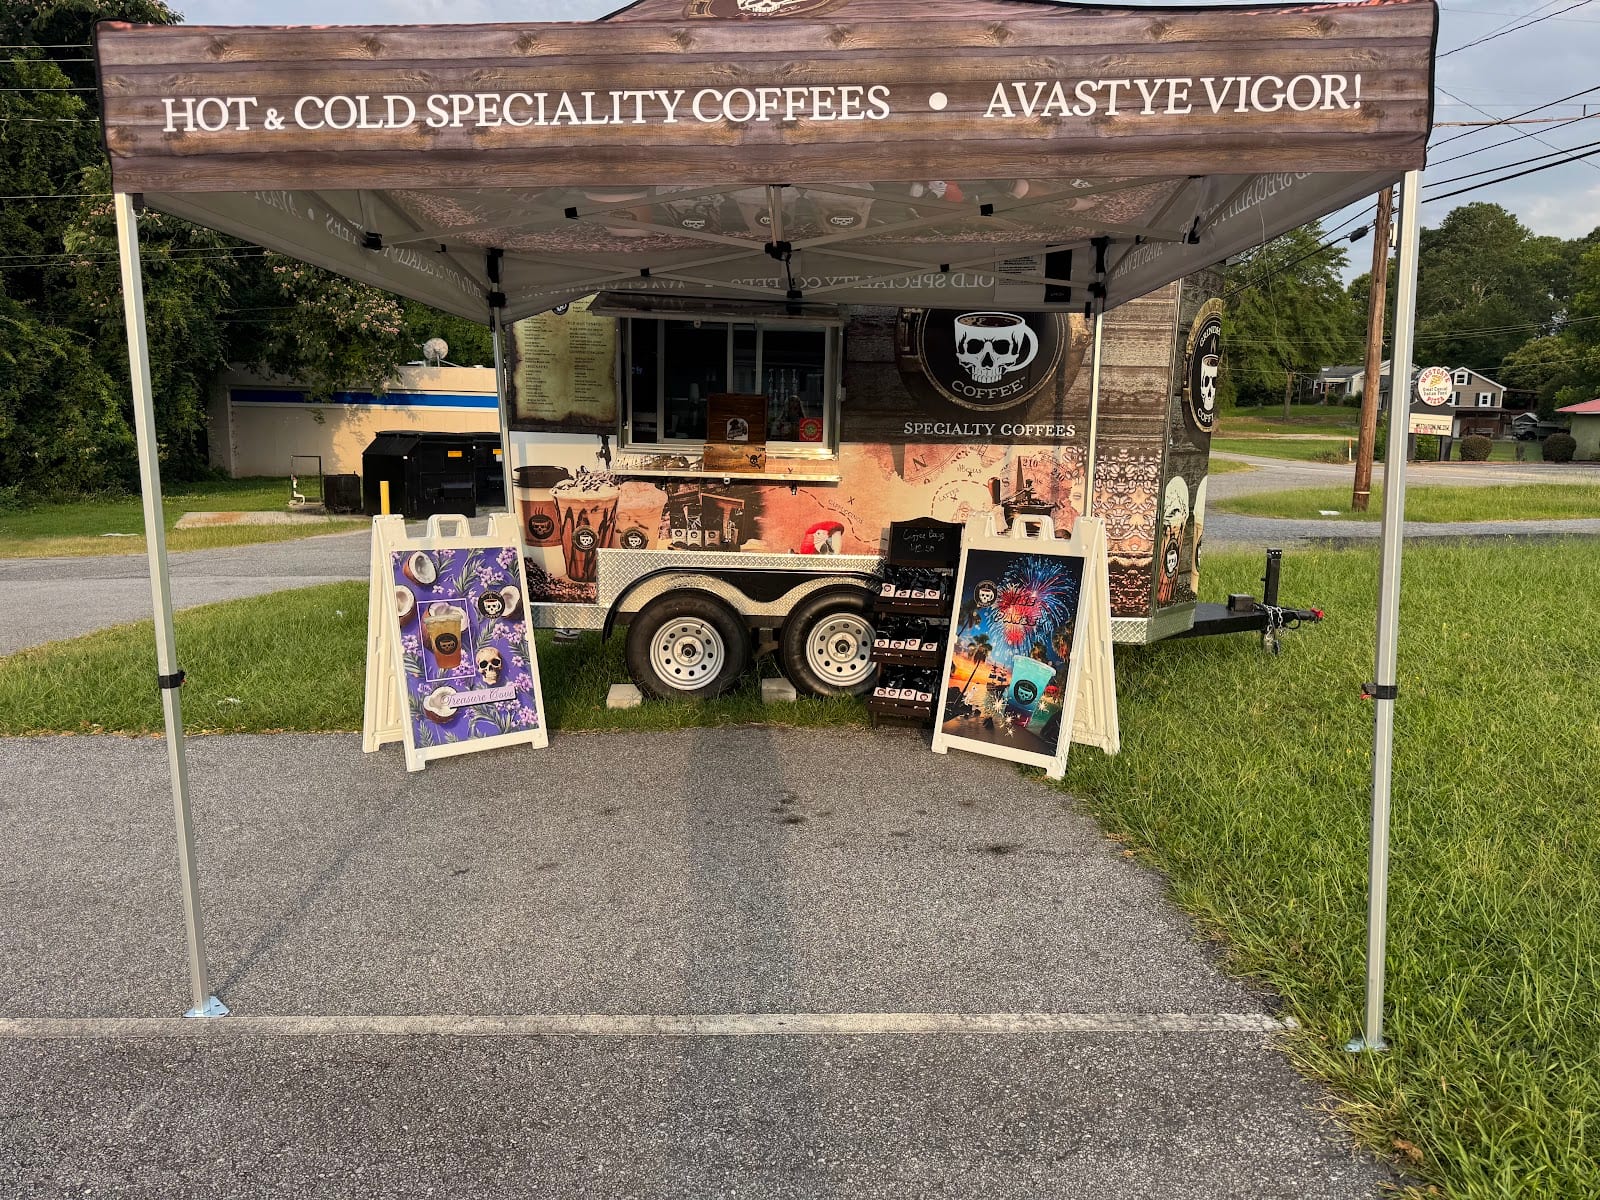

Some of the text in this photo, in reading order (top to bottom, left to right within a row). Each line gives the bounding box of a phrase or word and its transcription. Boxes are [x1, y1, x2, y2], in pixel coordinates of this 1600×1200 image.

[161, 96, 258, 133] HOT
[264, 108, 286, 131] &
[294, 95, 416, 130] COLD
[426, 89, 686, 128] SPECIALITY
[691, 85, 891, 123] COFFEES
[1200, 73, 1362, 114] VIGOR!
[951, 377, 1024, 400] COFFEE
[903, 421, 1076, 438] SPECIALTY COFFEES
[440, 687, 514, 706] Treasure Cove
